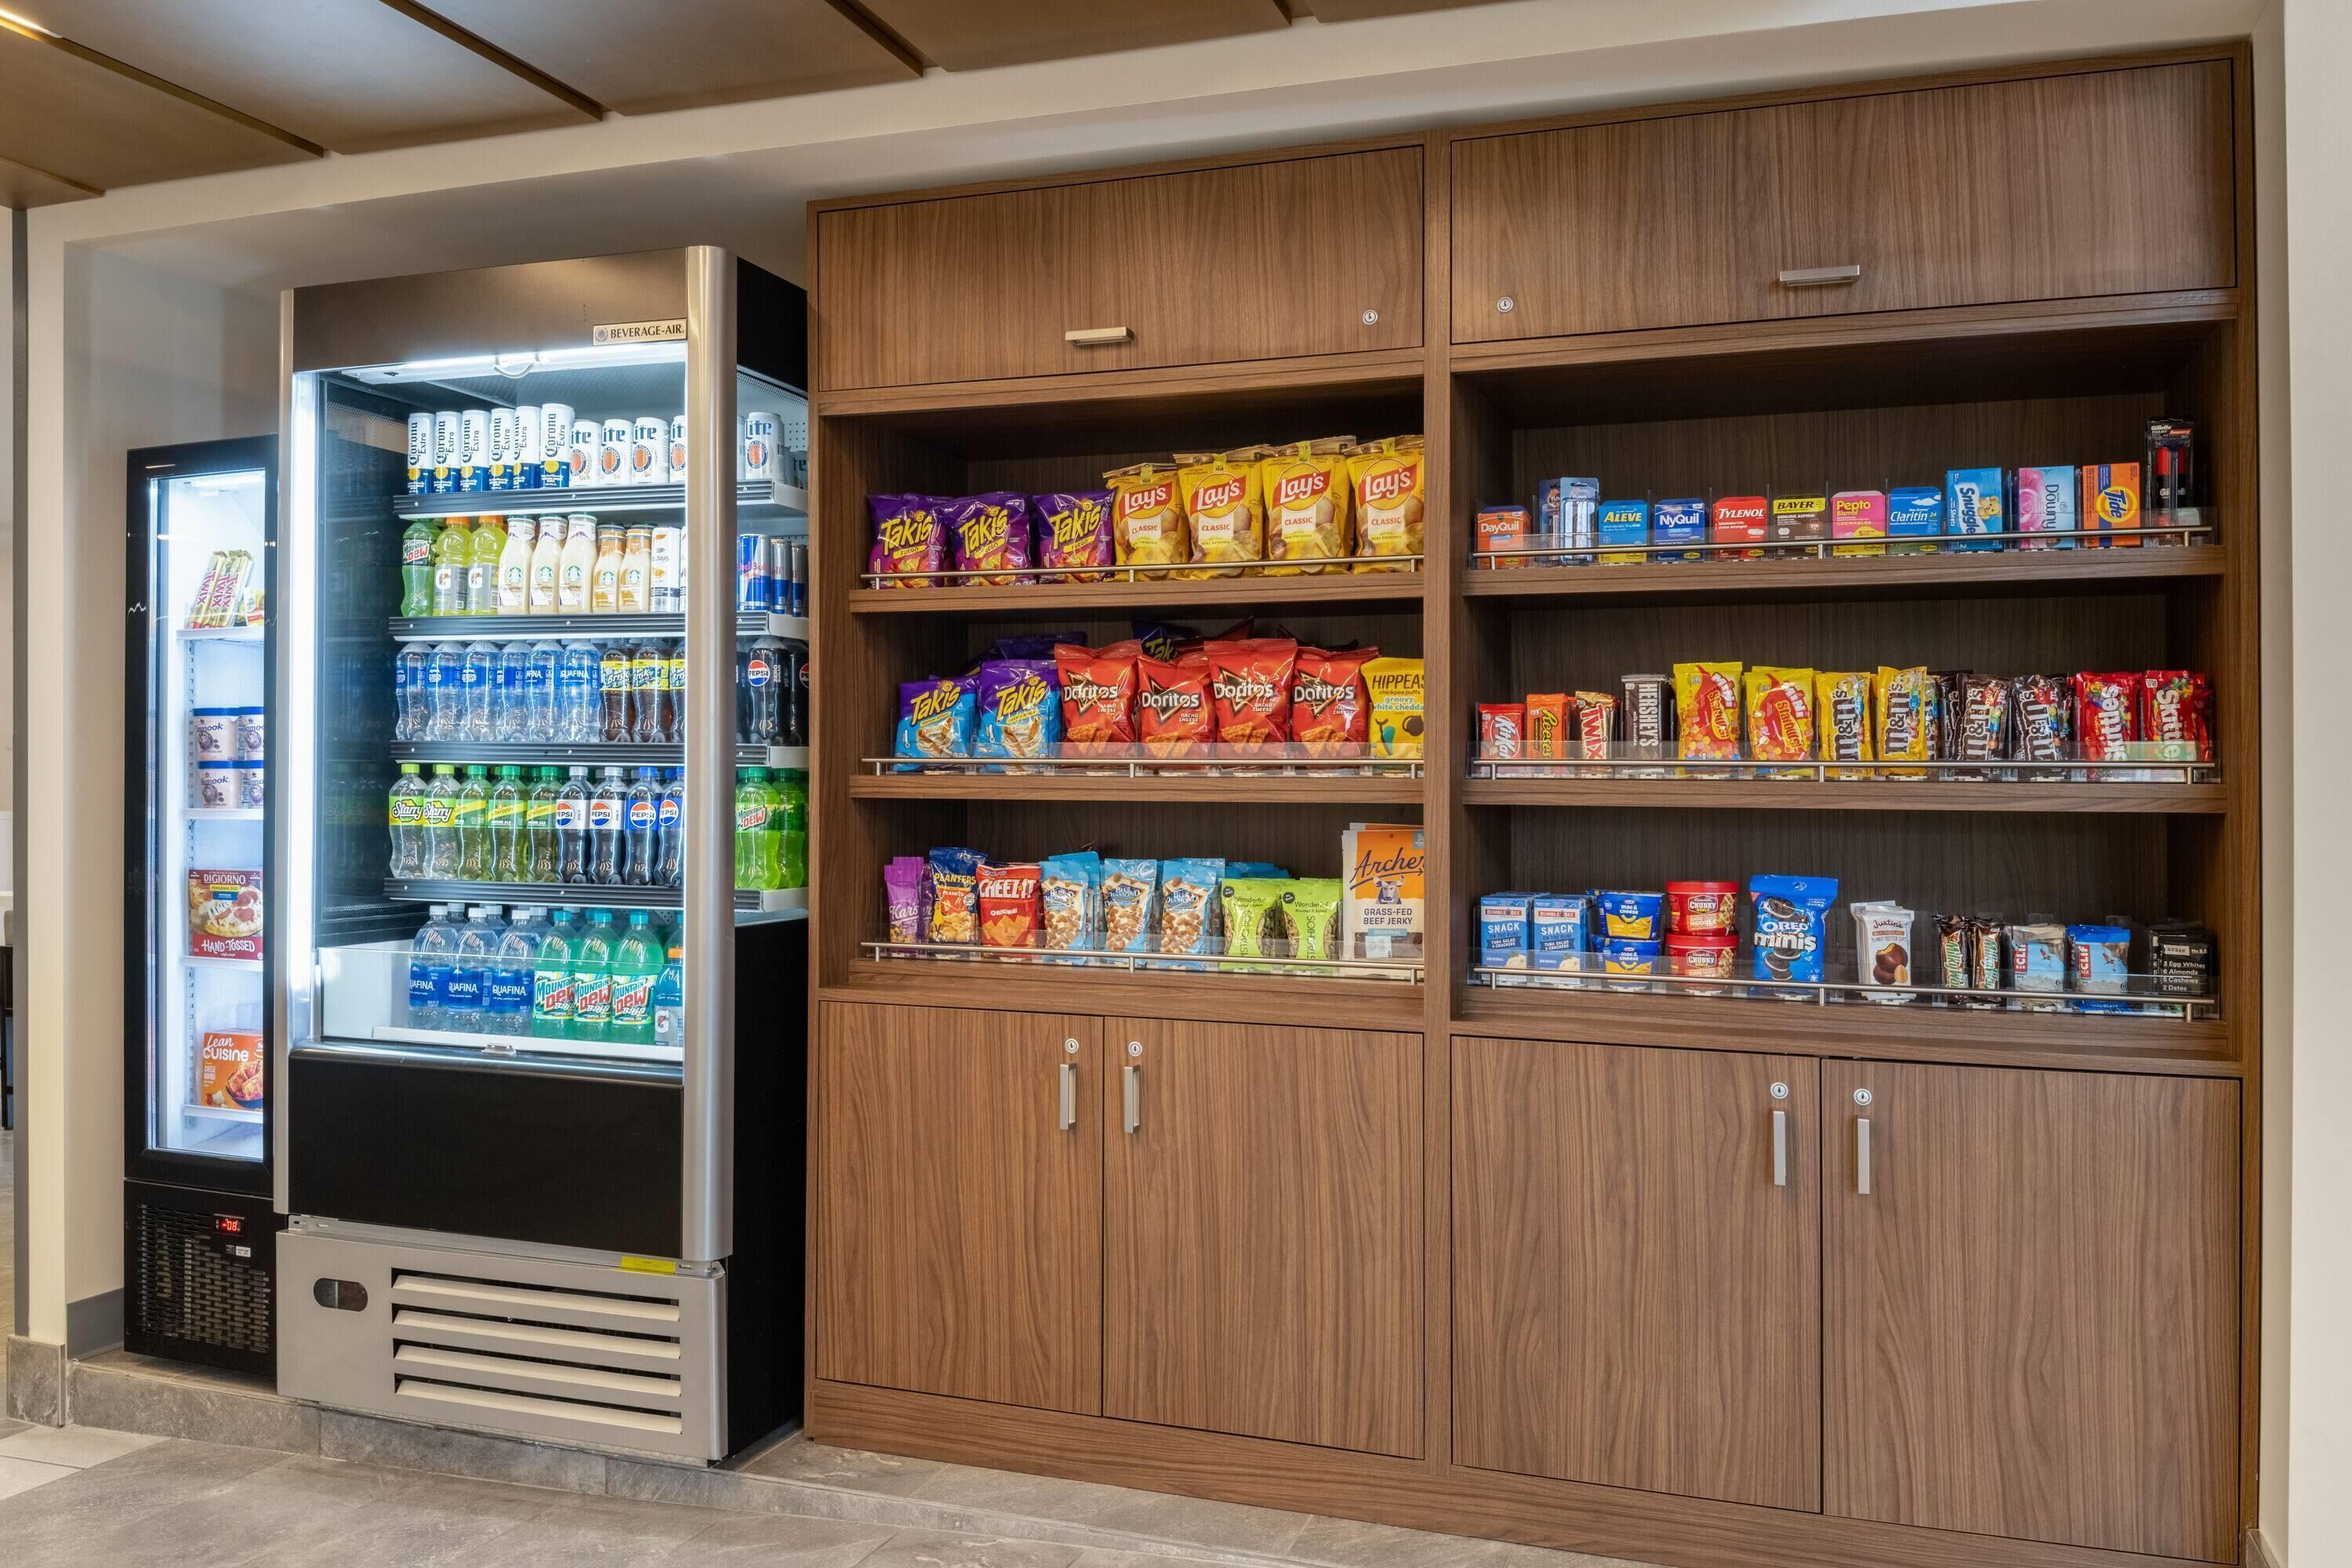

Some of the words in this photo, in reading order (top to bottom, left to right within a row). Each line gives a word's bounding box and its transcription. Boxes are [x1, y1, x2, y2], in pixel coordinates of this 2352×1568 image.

[611, 324, 683, 339] BEVERAGE-AIR
[408, 422, 419, 466] Corona
[436, 420, 447, 464] Corona
[462, 419, 474, 463] Corona
[492, 418, 503, 461] Corona
[545, 413, 557, 457] Corona
[1280, 473, 1324, 503] Lay's
[1366, 467, 1410, 502] Lay's
[1124, 486, 1167, 515] Lay's
[1197, 480, 1240, 510] Lay's
[2103, 489, 2127, 519] Tide
[1719, 509, 1765, 519] TYLENOL
[1777, 501, 1814, 510] BAYER
[1837, 500, 1871, 511] Pepto
[1959, 488, 1980, 533] Snuggle
[2042, 485, 2060, 529] Downy
[1050, 503, 1101, 550] Takis
[1603, 511, 1642, 523] ALEVE
[1660, 514, 1699, 528] NyQuil
[1890, 511, 1928, 522] Claritin
[881, 514, 932, 555] Takis
[960, 508, 1007, 557] Takis
[1132, 524, 1158, 534] CLASSIC
[1481, 521, 1519, 534] DayQuil
[901, 546, 920, 556] FUEGO
[1071, 539, 1088, 550] FUEGO
[197, 571, 216, 605] TWIX
[212, 573, 230, 608] TWIX
[1064, 684, 1119, 702] Doritos
[1142, 692, 1200, 708] Doritos
[1214, 681, 1274, 699] Doritos
[1294, 685, 1355, 702] Doritos
[911, 684, 961, 725] Takis
[996, 679, 1047, 722] Takis
[1581, 704, 1607, 759] TWIX
[392, 800, 423, 820] Starry
[424, 801, 452, 820] Starry
[935, 873, 976, 884] PLANTERS
[889, 904, 919, 919] Kar's
[1488, 923, 1519, 933] SNACK
[1541, 924, 1573, 935] SNACK
[1762, 921, 1809, 933] OREO
[1874, 919, 1904, 928] Justin's
[1754, 931, 1817, 951] minis
[2080, 946, 2089, 971] CLIF
